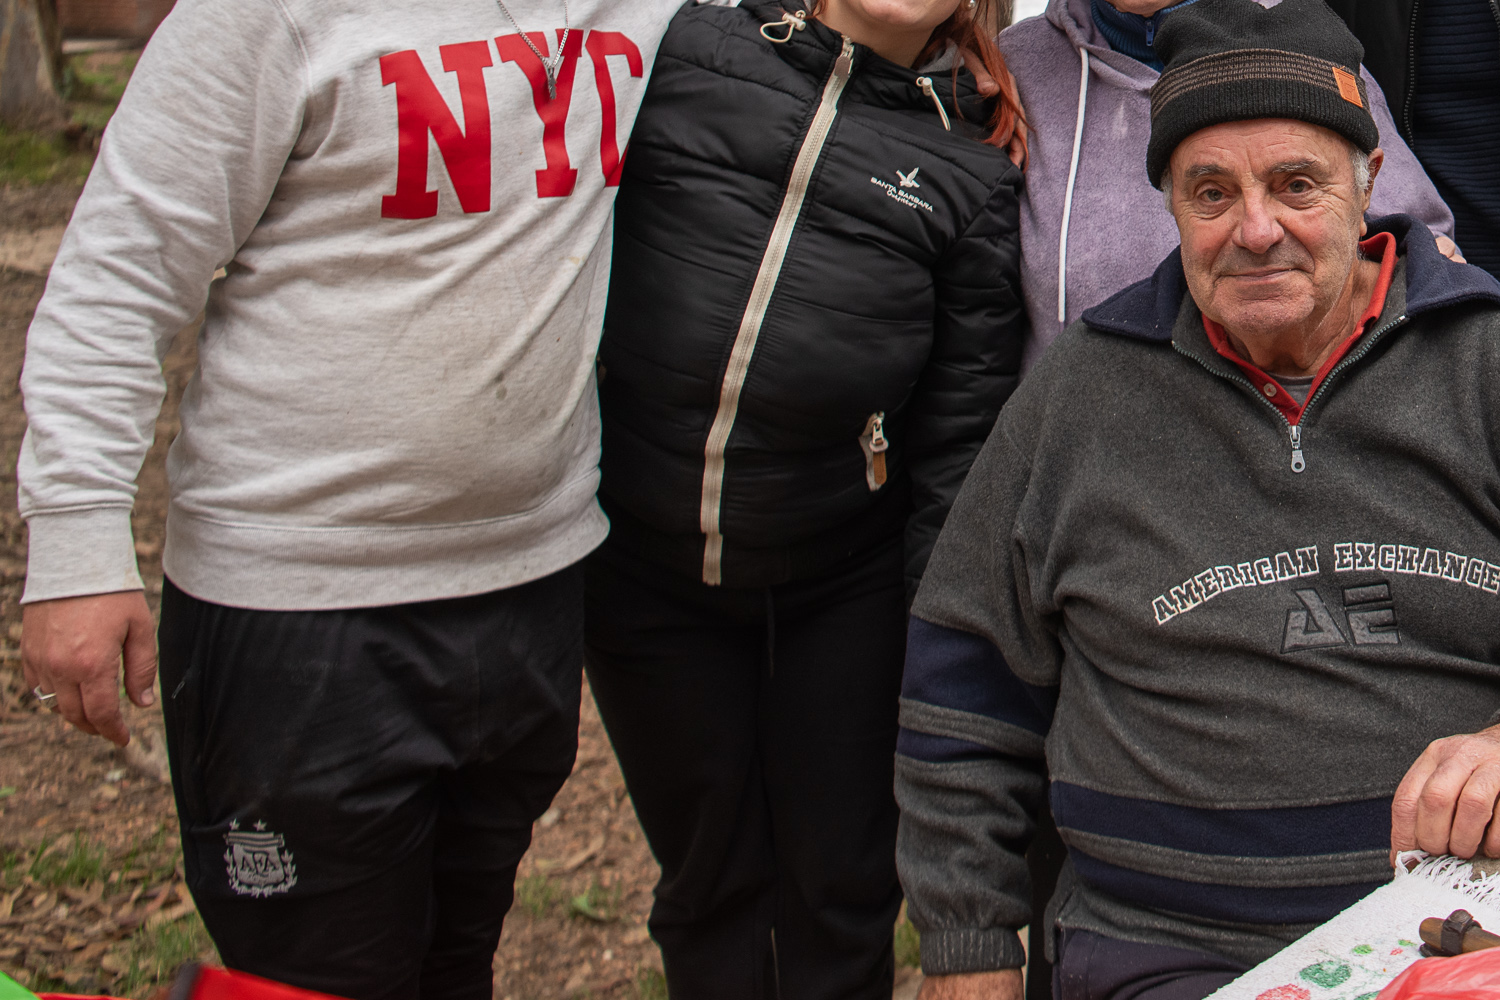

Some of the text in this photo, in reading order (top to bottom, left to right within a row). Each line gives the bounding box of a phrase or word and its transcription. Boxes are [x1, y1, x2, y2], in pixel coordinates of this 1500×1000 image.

[379, 28, 643, 220] NYC
[870, 176, 933, 213] SANTA BARBARA
[1151, 545, 1320, 626] AMERICAN
[1279, 580, 1401, 655] AE
